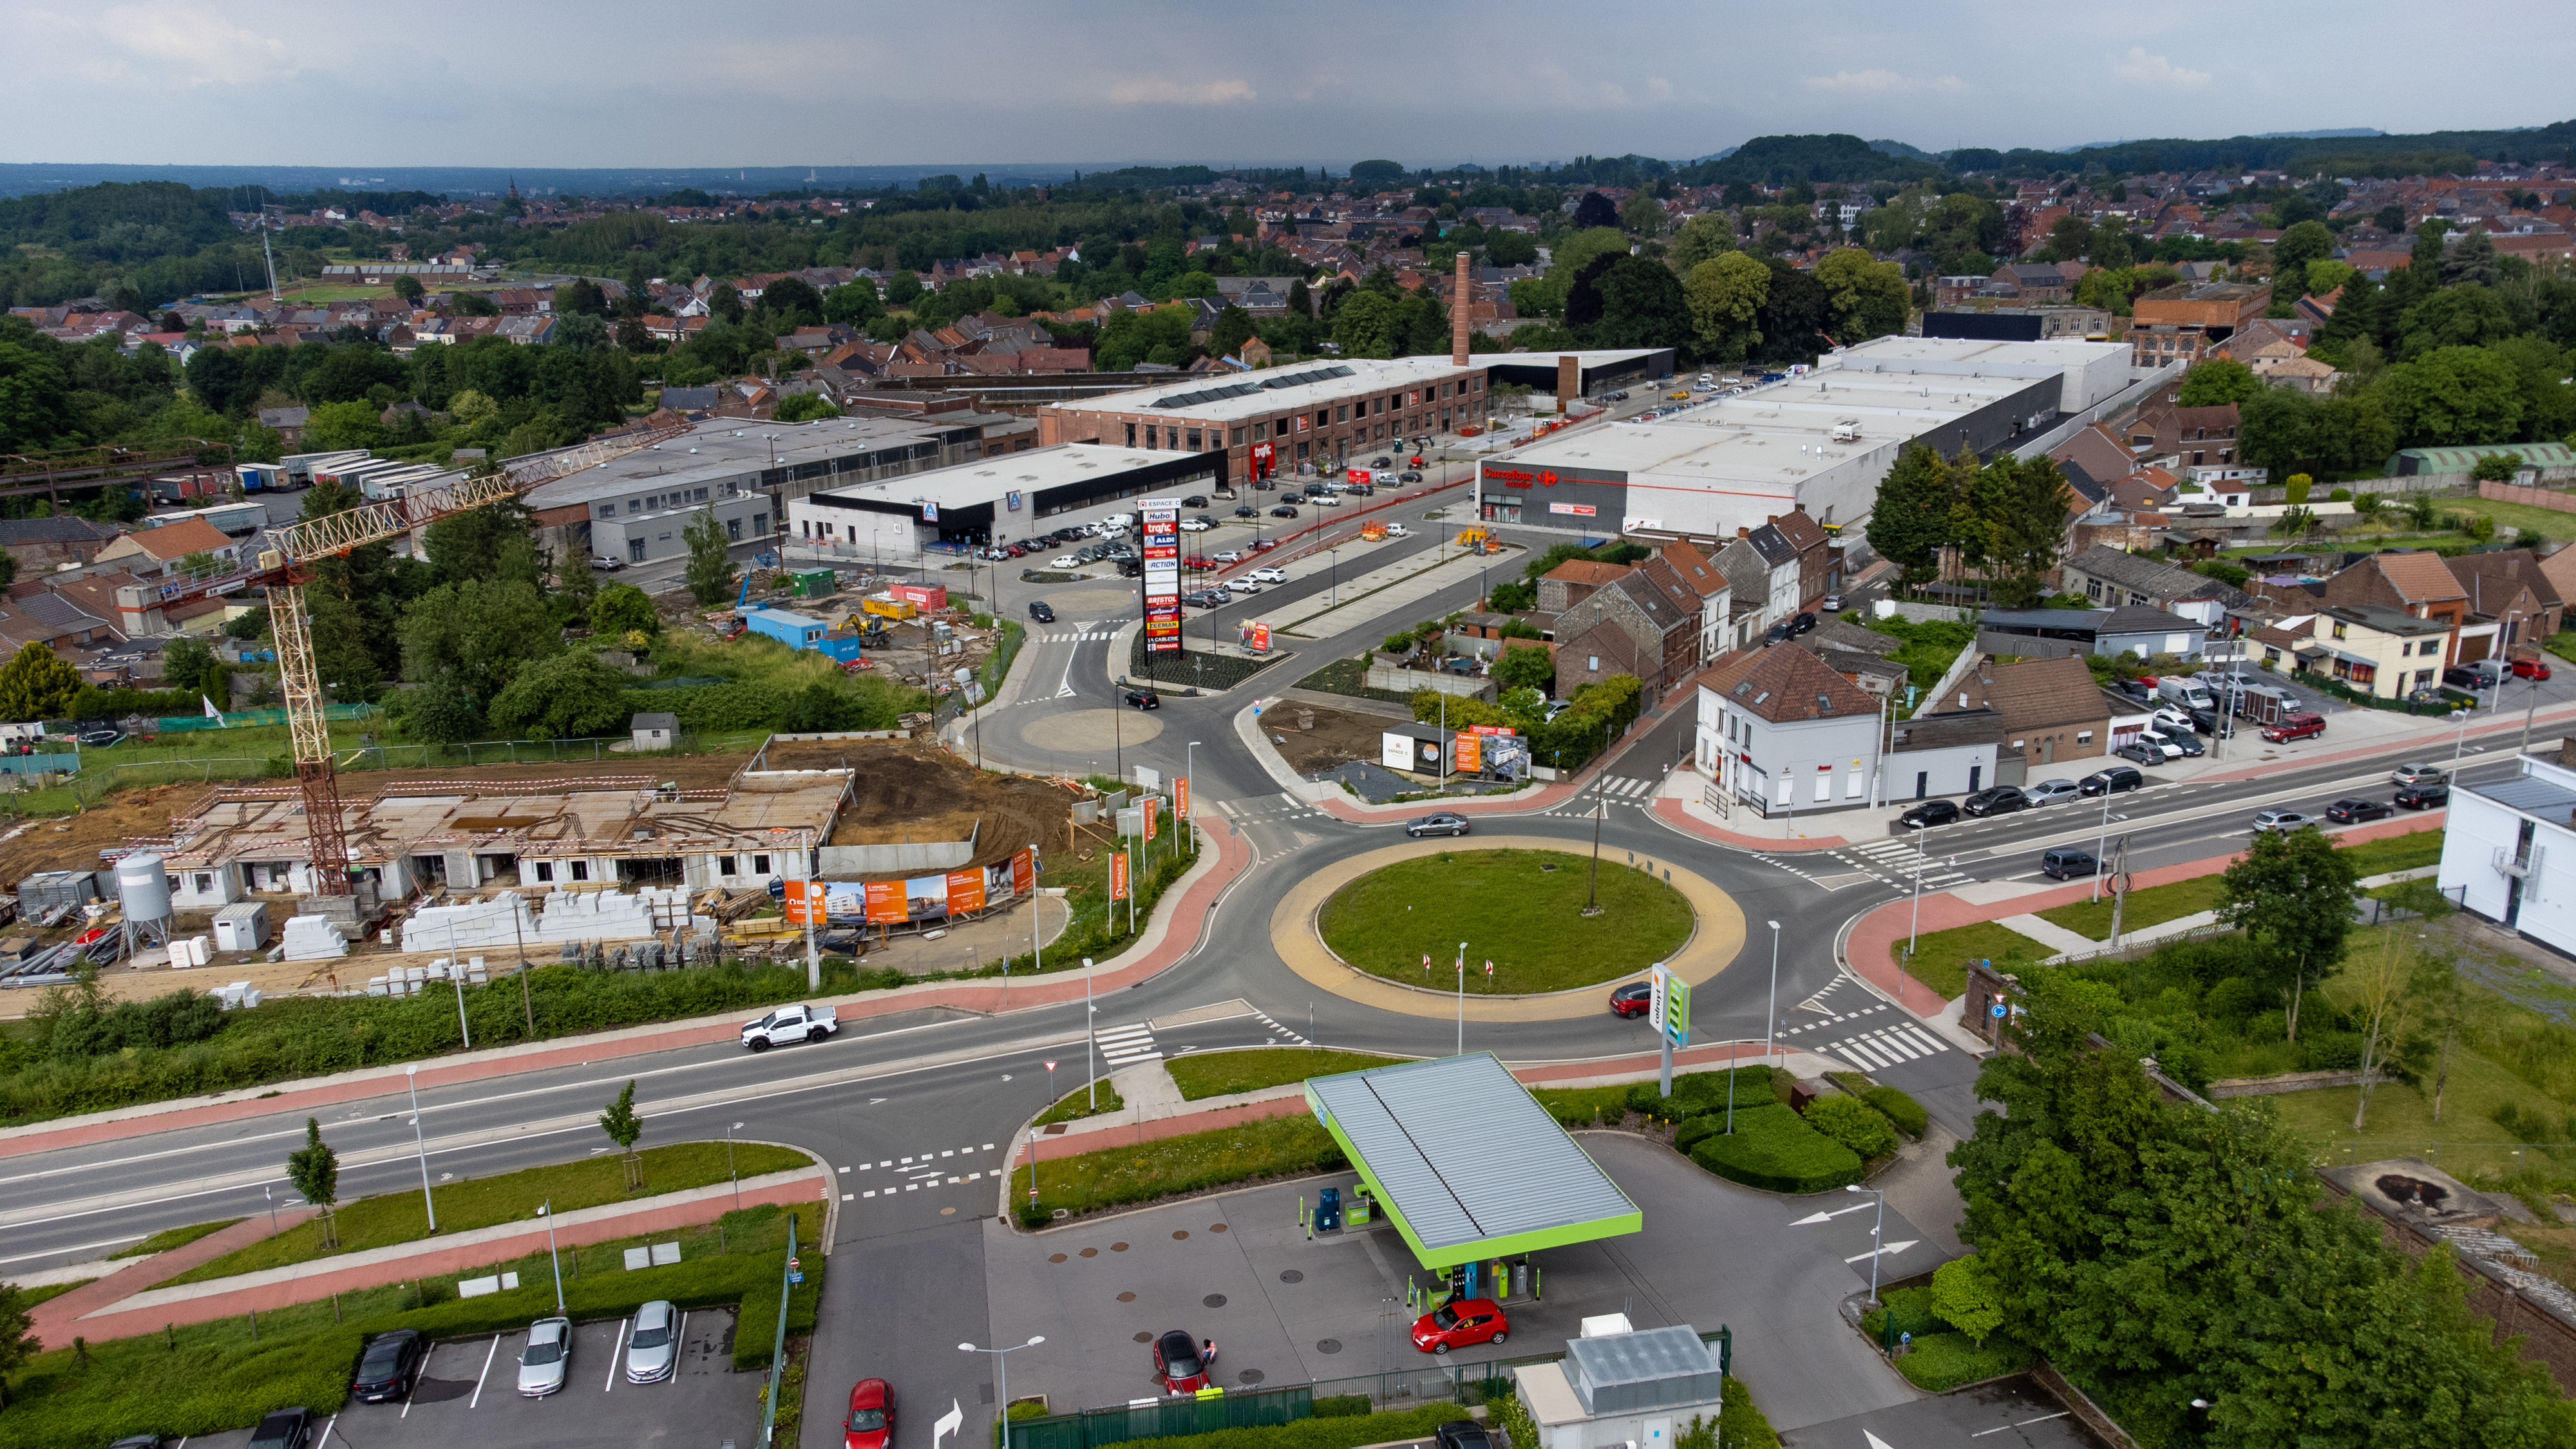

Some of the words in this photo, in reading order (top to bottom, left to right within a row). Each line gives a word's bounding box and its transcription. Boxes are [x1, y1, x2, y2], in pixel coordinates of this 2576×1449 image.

[1484, 467, 1534, 480] Carrefour
[1148, 523, 1173, 533] trafic
[907, 592, 926, 601] VERELST
[1148, 596, 1177, 605] BRISTOL
[875, 602, 889, 612] MAES
